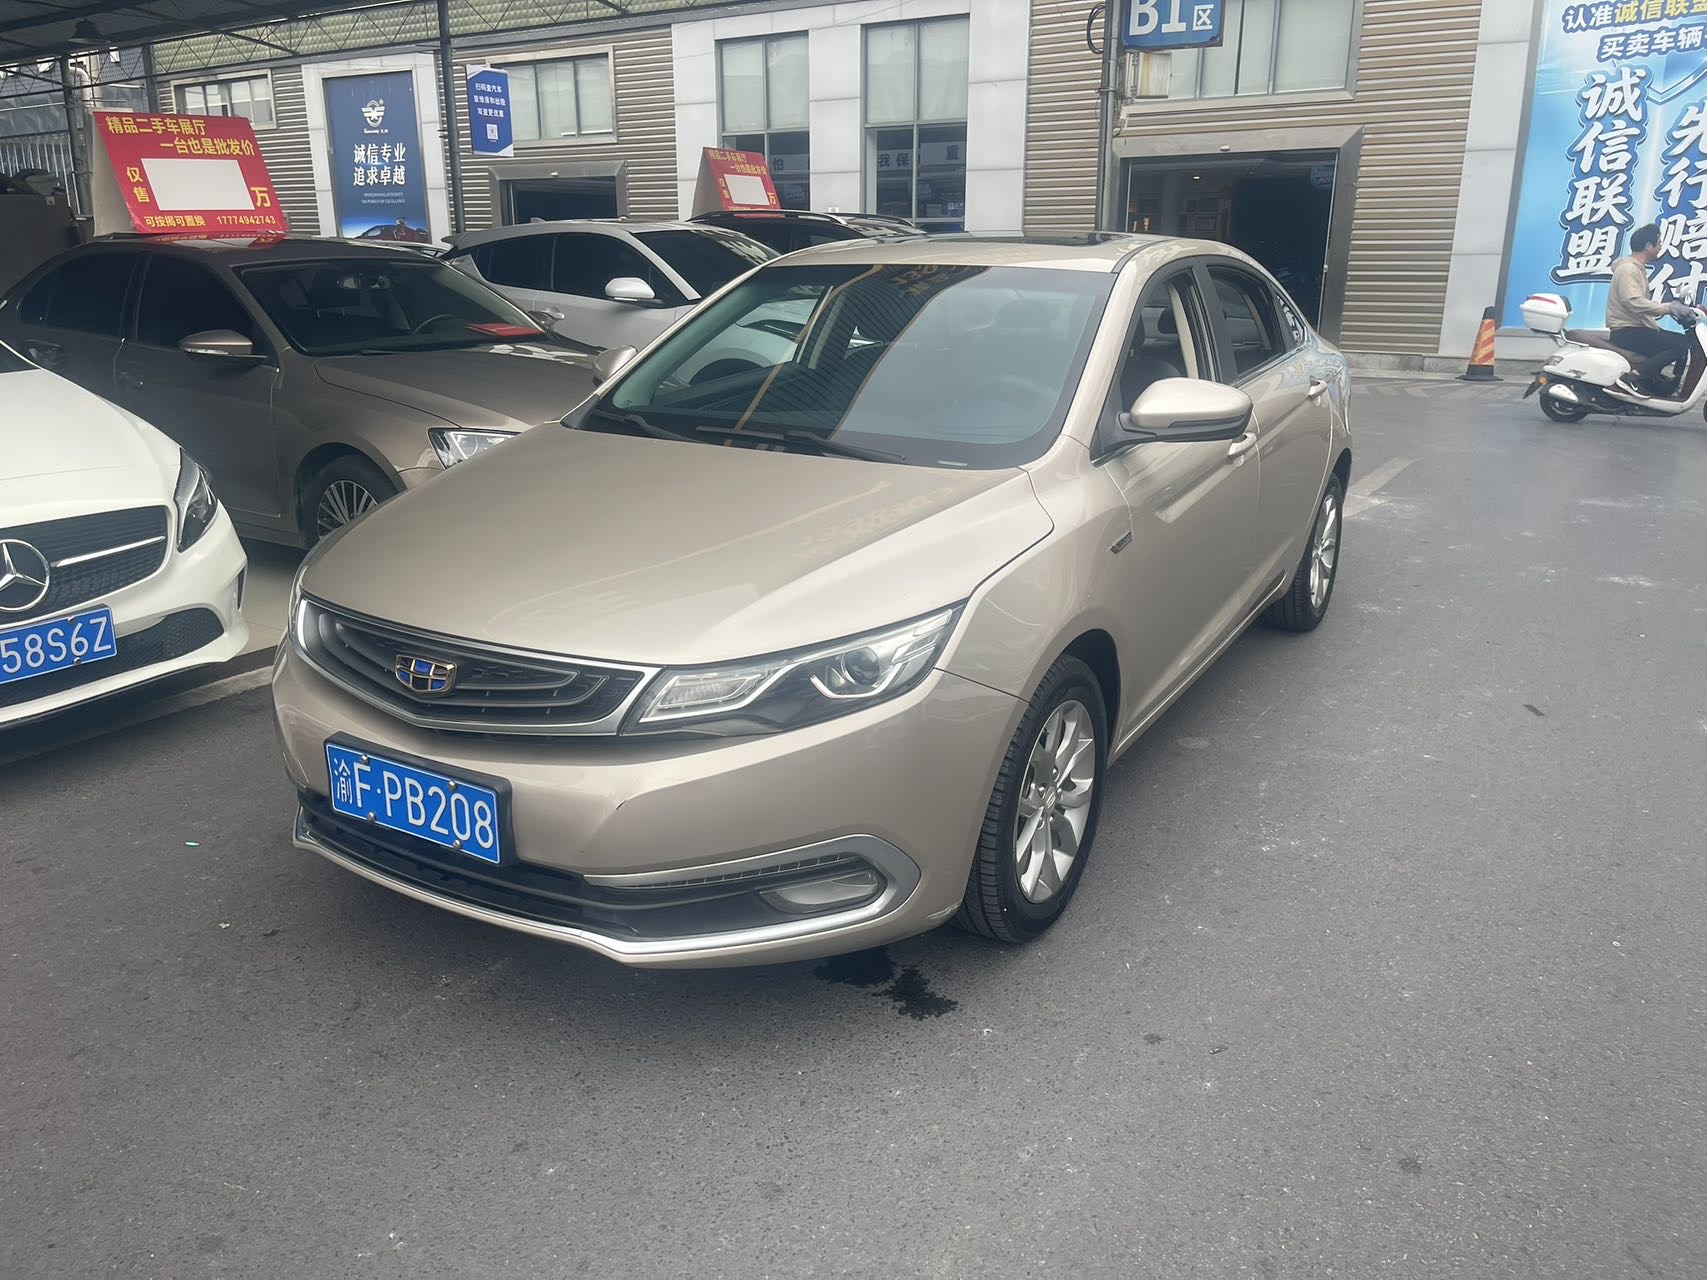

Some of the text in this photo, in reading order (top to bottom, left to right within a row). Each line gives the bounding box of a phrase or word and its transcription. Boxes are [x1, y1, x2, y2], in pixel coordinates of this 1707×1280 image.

[1601, 26, 1707, 59] 买卖车辆
[105, 116, 206, 136] 精品二手车展厅
[160, 137, 256, 156] 一台也是批发价
[353, 142, 406, 165] 诚信专业
[353, 165, 406, 186] 追求卓越
[1556, 67, 1647, 279] 诚信联盟
[126, 166, 150, 203] 仅售
[250, 186, 271, 208] 万
[144, 215, 206, 228] 可按揭可置换
[216, 215, 276, 225] 17774942743
[0, 616, 112, 674] 58S6Z
